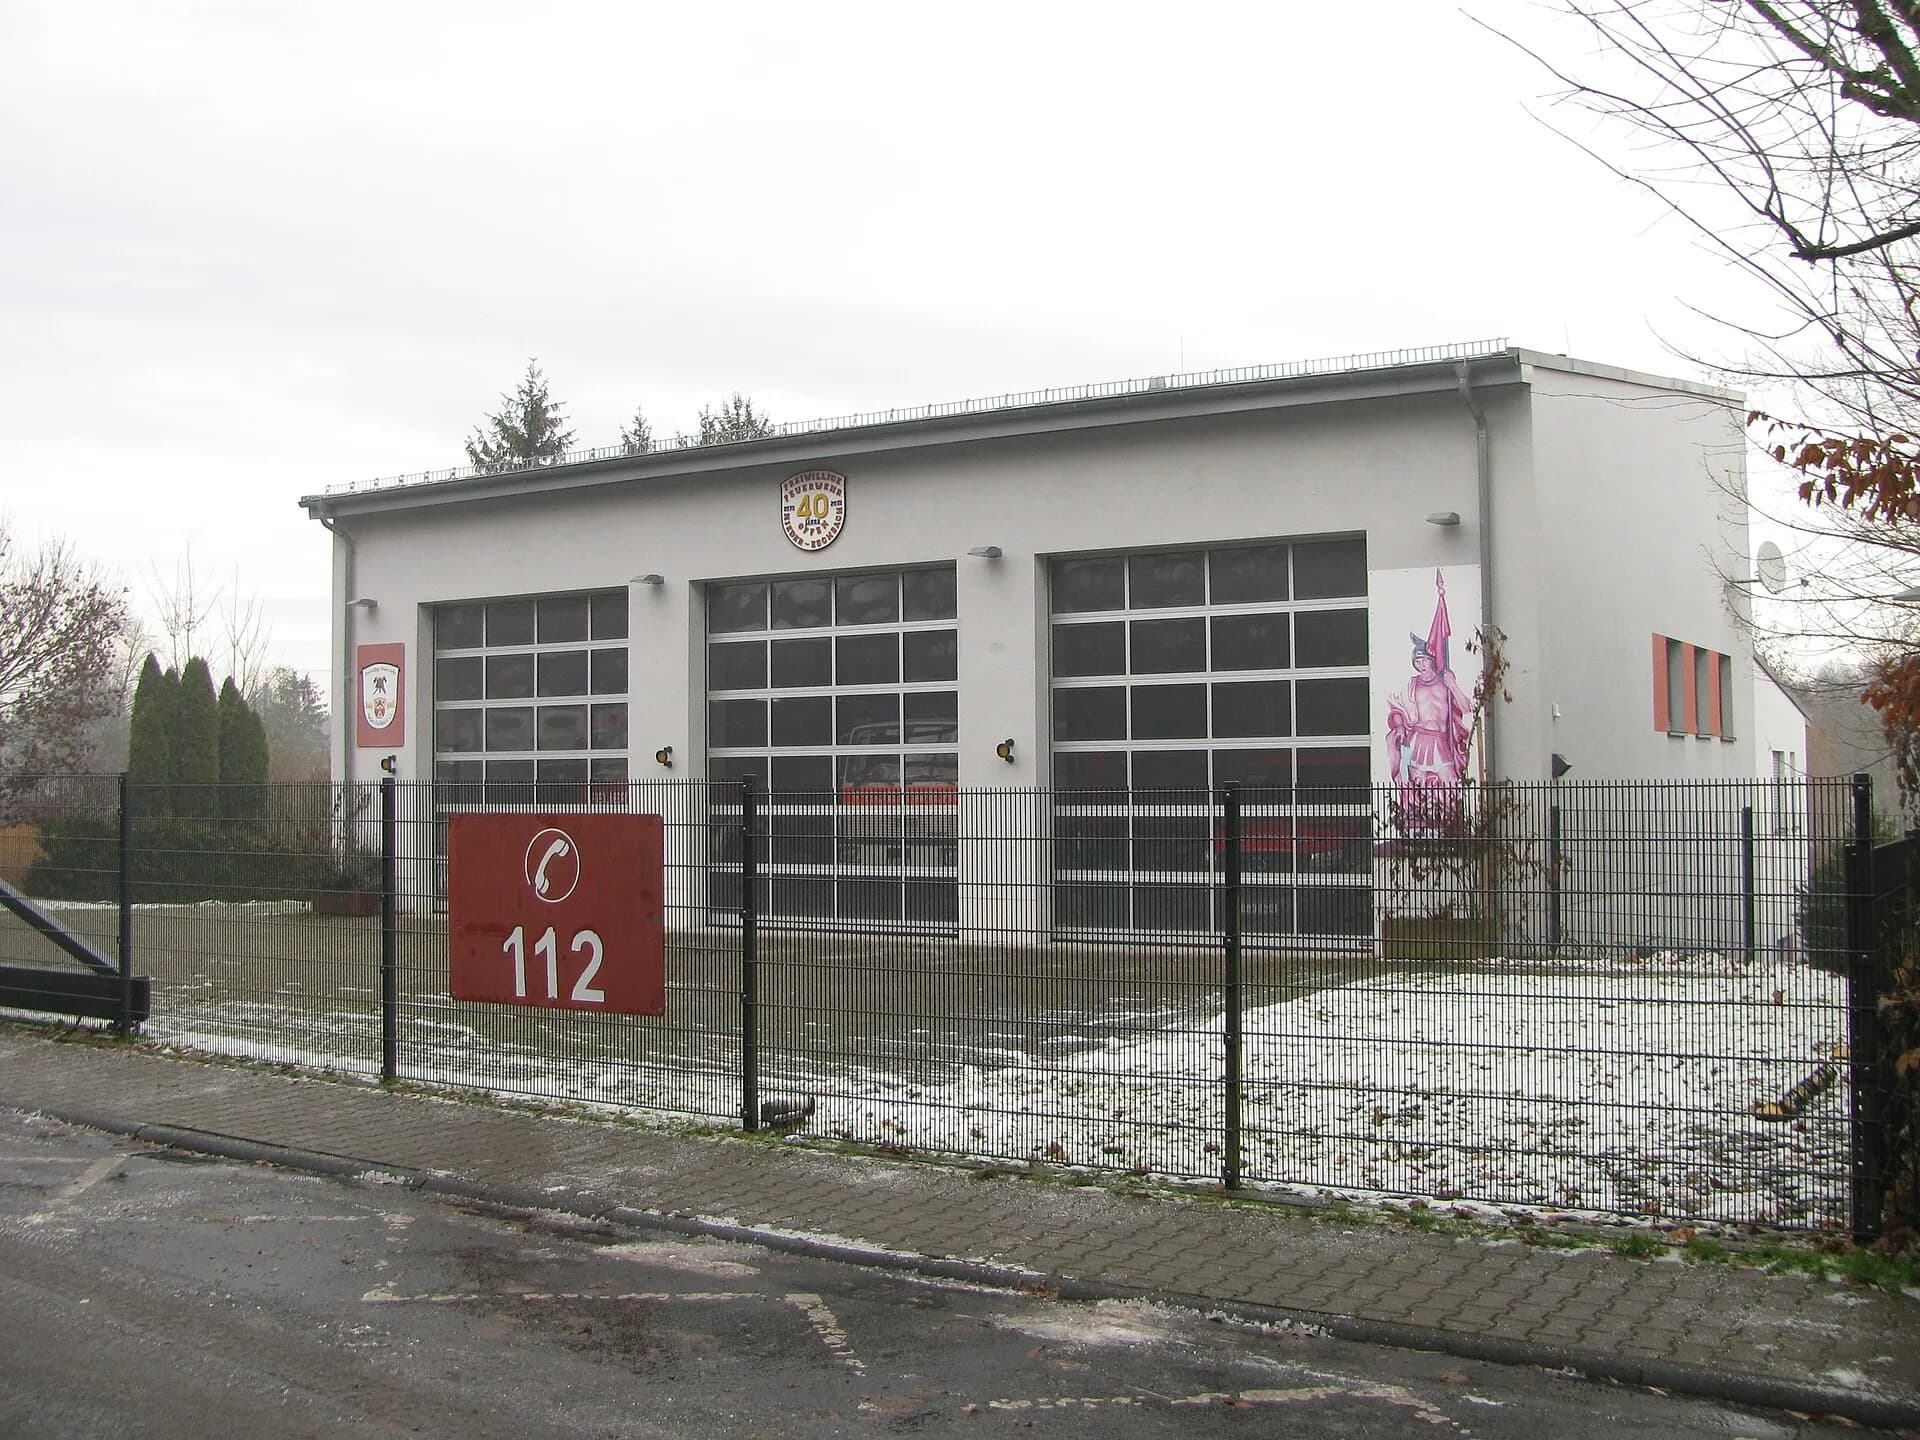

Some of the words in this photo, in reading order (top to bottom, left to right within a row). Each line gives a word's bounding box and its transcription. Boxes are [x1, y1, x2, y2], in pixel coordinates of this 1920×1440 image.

[783, 471, 843, 492] FREIWILLIGE
[783, 482, 843, 503] FEUERWEHR
[796, 493, 829, 519] 40
[503, 926, 605, 1002] 112
